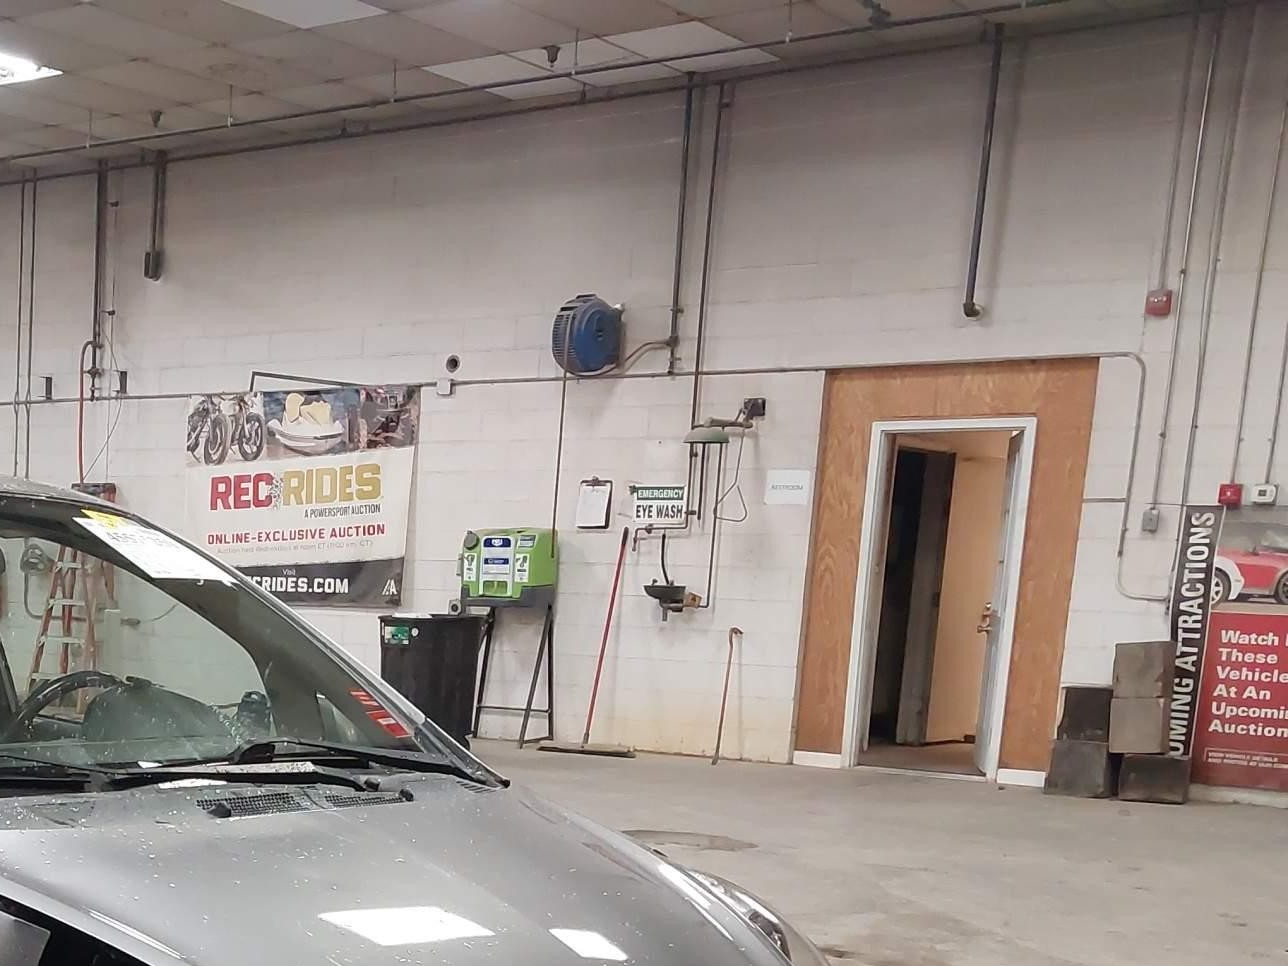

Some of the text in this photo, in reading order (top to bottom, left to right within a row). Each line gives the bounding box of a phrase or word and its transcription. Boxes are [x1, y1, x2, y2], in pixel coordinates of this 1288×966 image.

[282, 463, 381, 505] RIDES
[638, 488, 683, 499] EMERGENCY
[351, 504, 380, 515] AUCTION
[636, 504, 683, 519] EYE WASH
[208, 523, 385, 545] ONLINE-EXCLUSIVE AUCTION
[1175, 512, 1215, 672] ATTRACTIONS
[1221, 630, 1279, 646] Watch
[1219, 647, 1278, 664] These
[1213, 684, 1271, 700] At An
